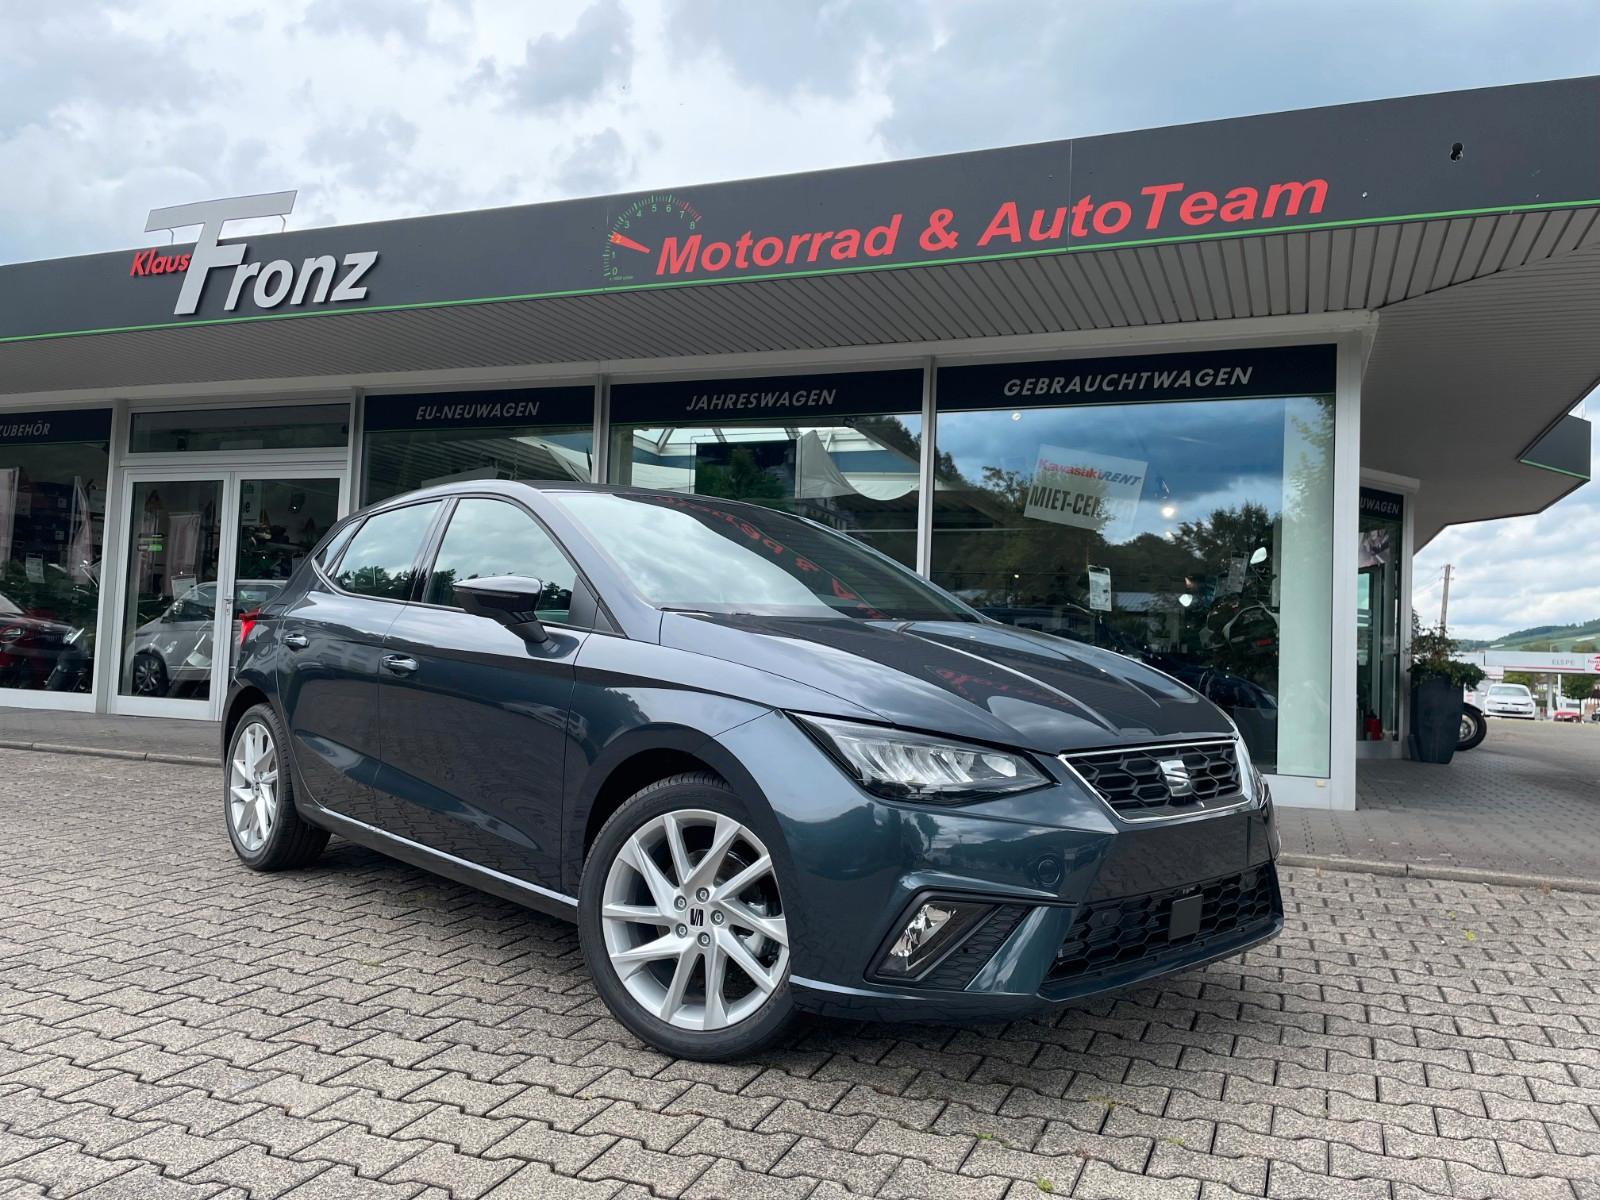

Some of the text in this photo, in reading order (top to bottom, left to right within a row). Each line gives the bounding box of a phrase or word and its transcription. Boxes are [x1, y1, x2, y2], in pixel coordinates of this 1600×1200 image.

[144, 190, 379, 316] Fronz
[656, 213, 903, 276] Motorrad
[919, 208, 959, 251] &
[129, 249, 191, 277] Klaus
[1003, 366, 1254, 397] GEBRAUCHTWAGEN
[415, 401, 540, 421] EU-NEUWAGEN
[686, 388, 837, 413] JAHRESWAGEN
